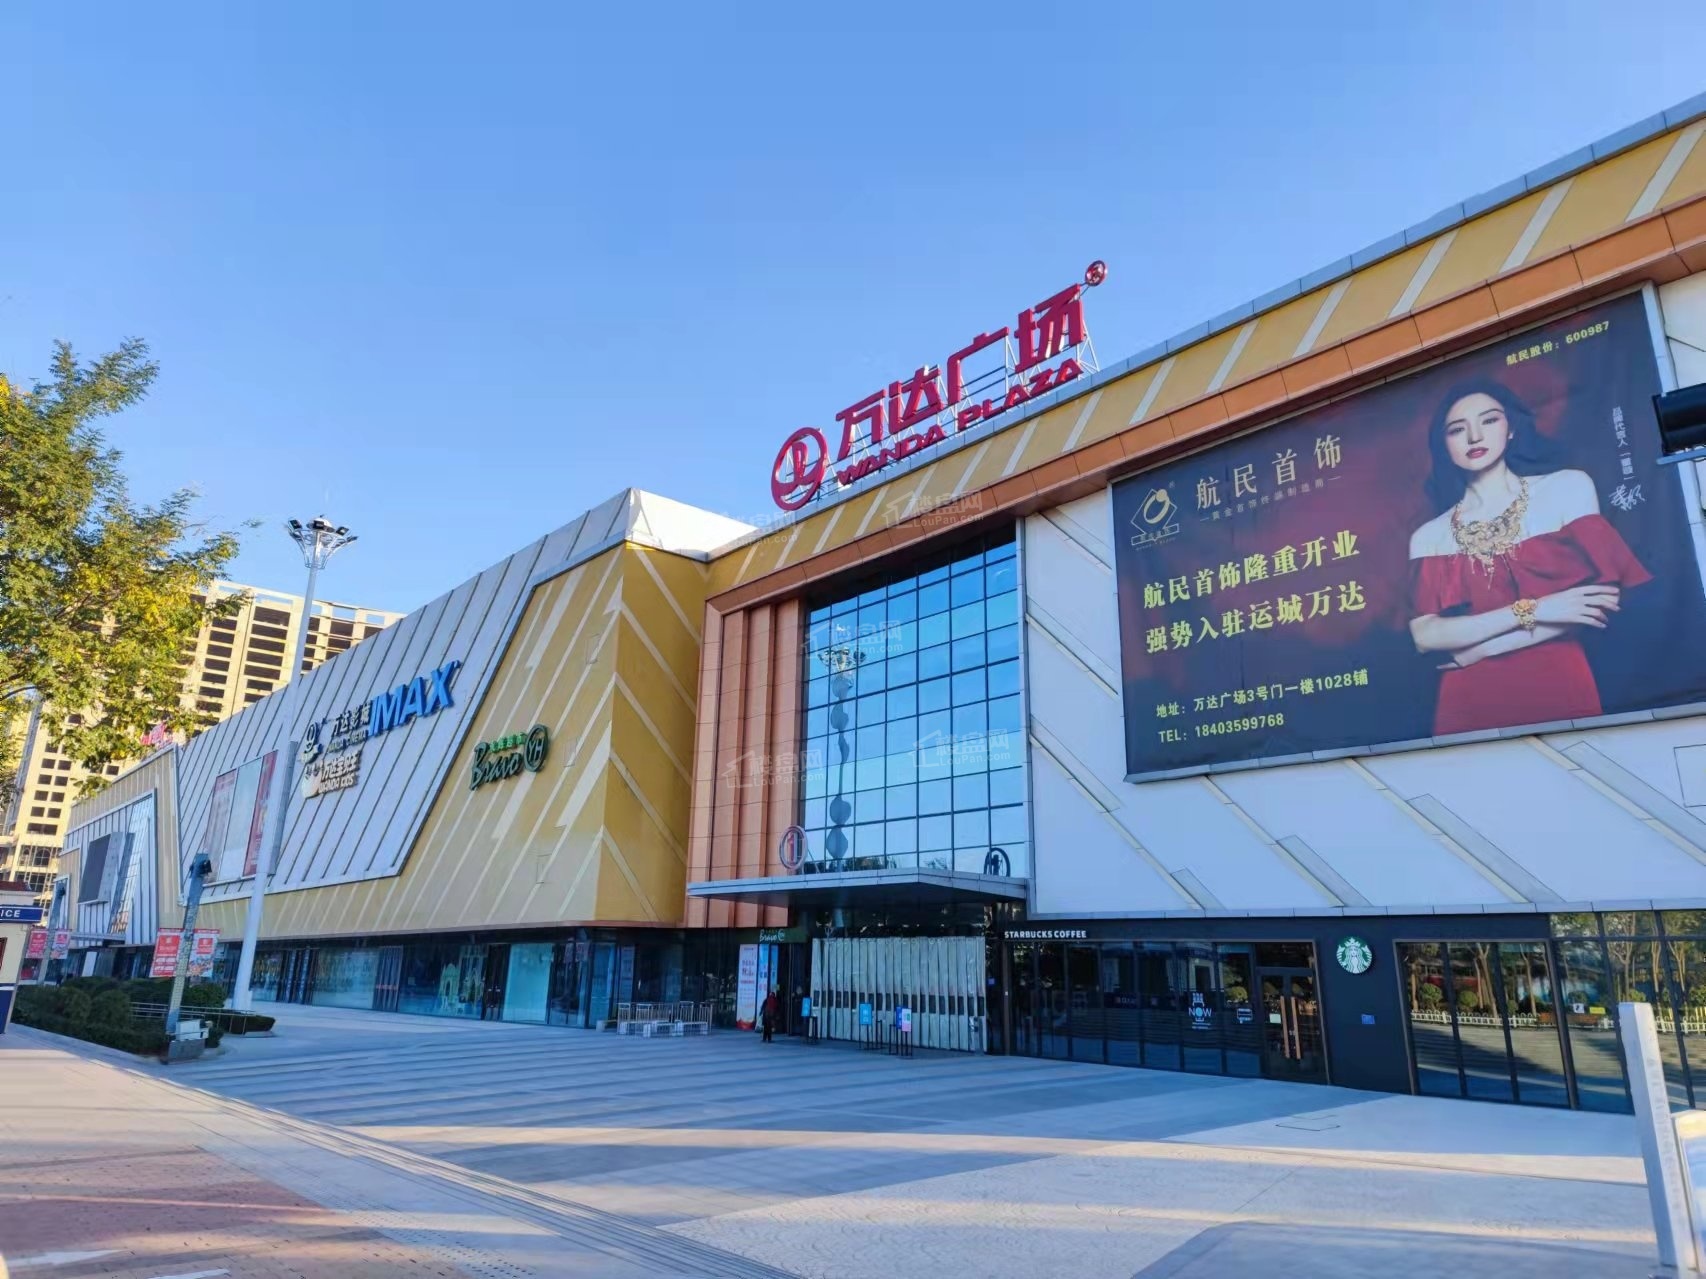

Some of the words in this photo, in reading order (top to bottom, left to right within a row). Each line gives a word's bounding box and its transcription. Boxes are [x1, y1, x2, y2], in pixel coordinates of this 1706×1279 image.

[836, 284, 1086, 461] 万达广场
[836, 424, 947, 486] WANDA
[957, 358, 1084, 432] PLAZA
[1196, 434, 1342, 510] 航民首饰
[1144, 530, 1360, 609] 航民首饰隆重开业
[1145, 581, 1367, 654] 强势入驻运城万达
[368, 662, 455, 737] IMAX
[469, 742, 524, 791] Bravo
[1004, 930, 1053, 939] STARBUCKS
[1053, 930, 1087, 939] COFFEE
